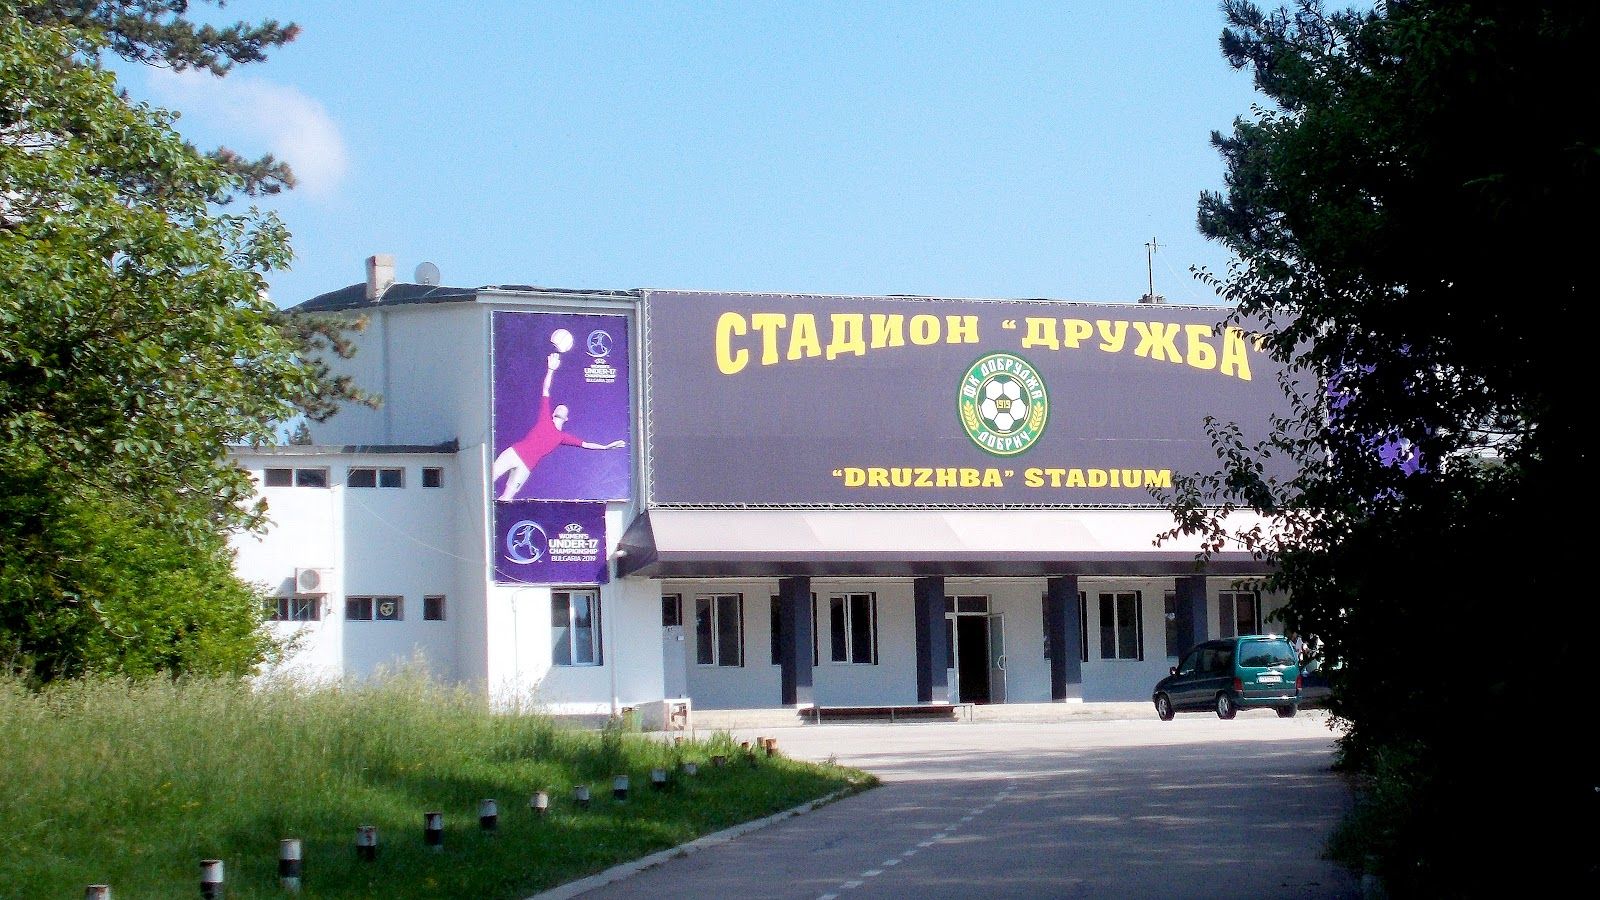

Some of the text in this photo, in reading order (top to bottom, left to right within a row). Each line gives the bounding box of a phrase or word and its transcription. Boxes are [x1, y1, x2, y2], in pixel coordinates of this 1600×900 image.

[715, 312, 980, 375] СТАДИОН
[980, 358, 1043, 399] ДОБРУДЖА
[996, 399, 1011, 409] 1919
[978, 431, 1031, 450] ДОБРИЧ
[1024, 468, 1172, 489] STADIUM
[548, 539, 599, 548] UNDER-17
